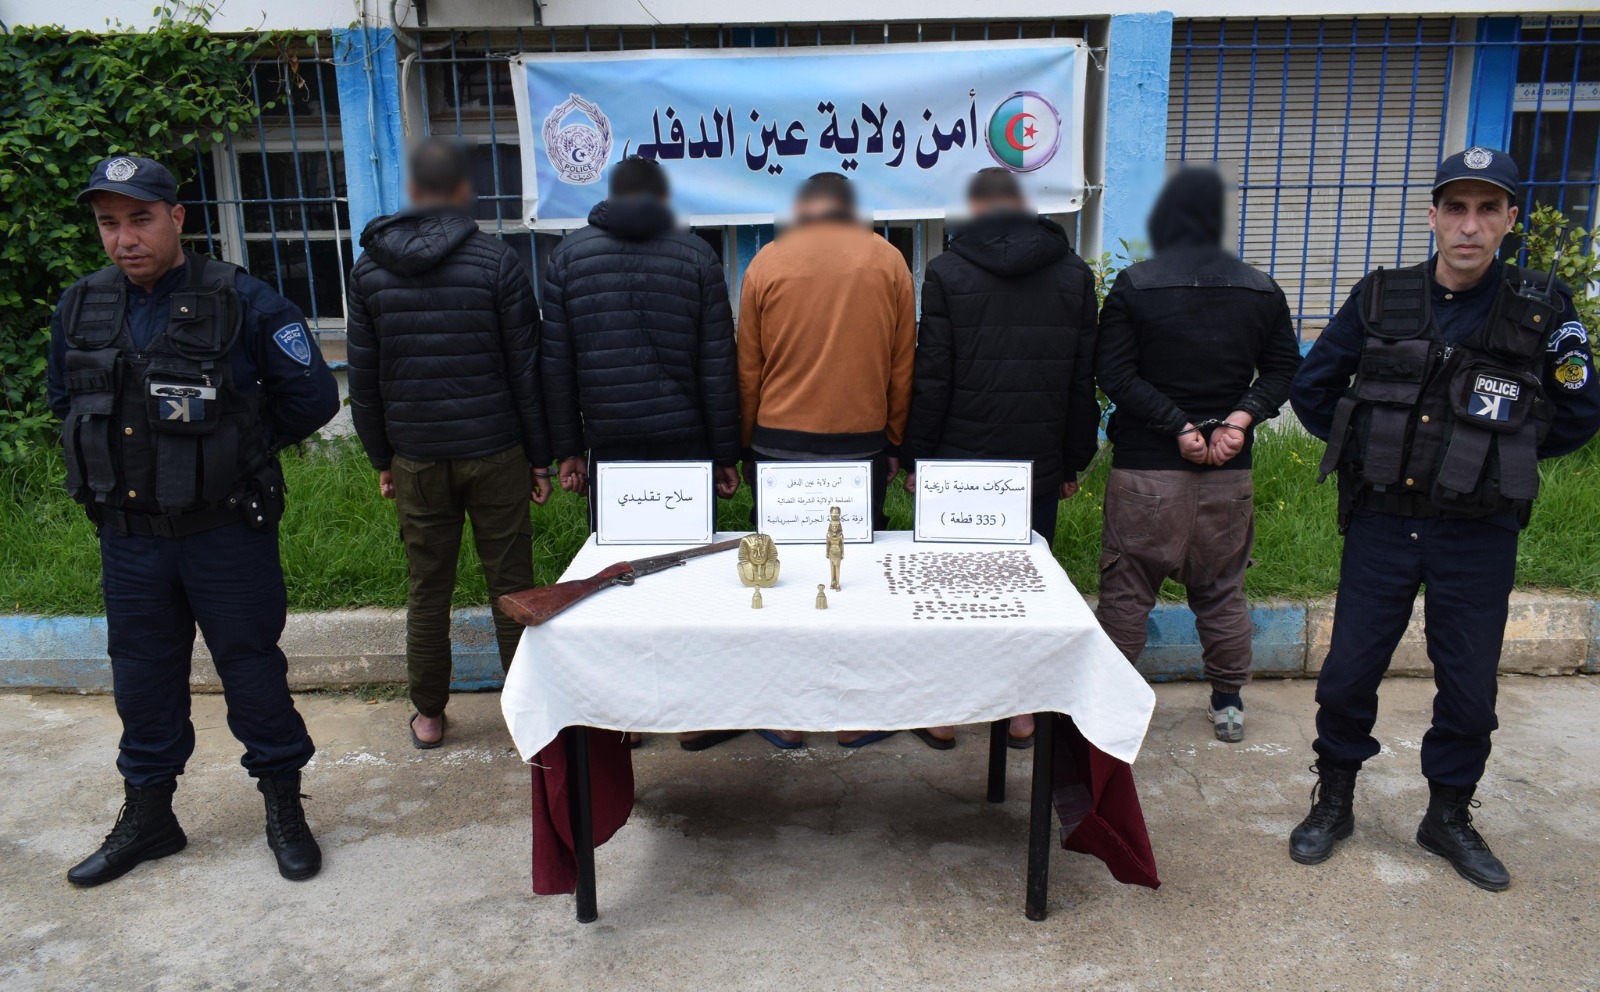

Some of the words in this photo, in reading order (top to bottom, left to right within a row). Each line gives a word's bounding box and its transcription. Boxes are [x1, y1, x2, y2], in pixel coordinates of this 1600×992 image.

[916, 88, 977, 169] أمن
[745, 108, 808, 175] عين
[817, 101, 905, 171] ولاية
[565, 163, 594, 173] POLICE
[1477, 377, 1518, 397] POLICE
[804, 479, 814, 488] عين
[816, 478, 830, 488] ولاية
[831, 477, 842, 488] أمن
[924, 479, 950, 494] تاريخية
[953, 480, 980, 493] معدنية
[983, 478, 1025, 495] مسكوكات
[617, 488, 661, 507] تقليدي
[665, 488, 693, 510] سلاح
[801, 514, 824, 527] الجرائم
[851, 514, 864, 525] فرقة
[950, 511, 973, 524] قطعة
[975, 514, 997, 526] 335
